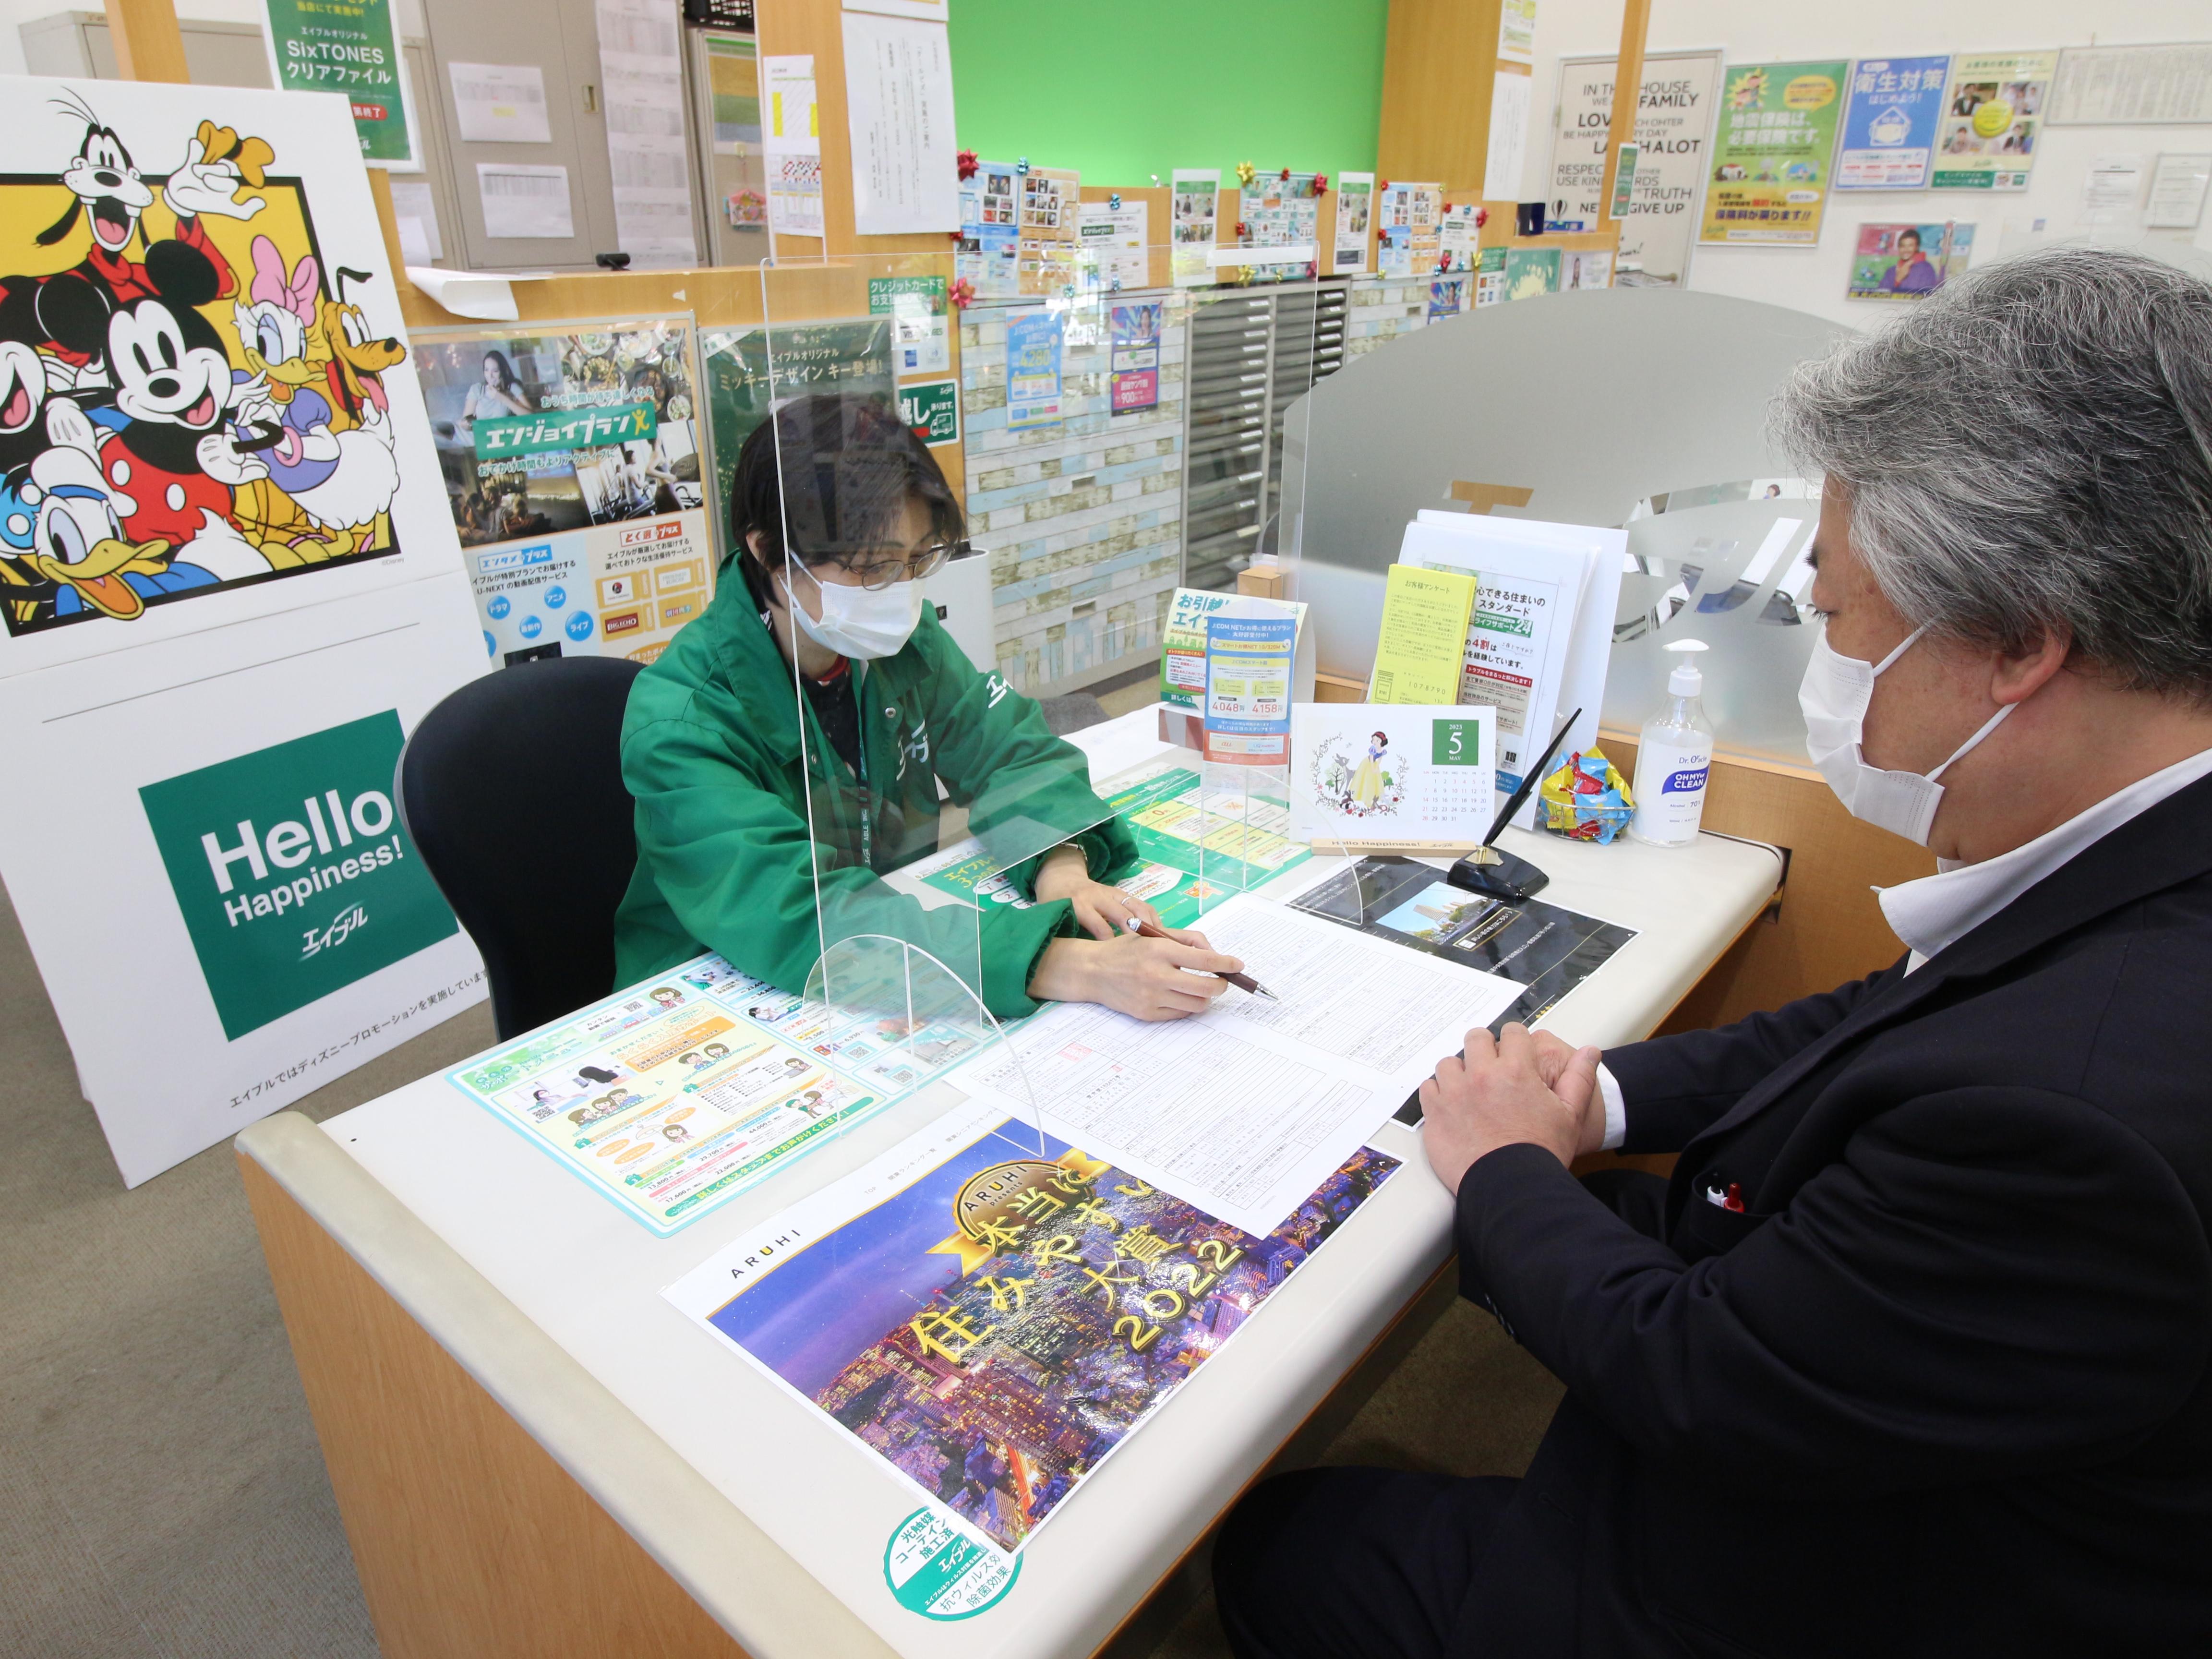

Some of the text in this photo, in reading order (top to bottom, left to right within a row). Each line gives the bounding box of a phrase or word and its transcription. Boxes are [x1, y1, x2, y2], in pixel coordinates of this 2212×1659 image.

[287, 40, 384, 64] SixTONES
[287, 61, 391, 84] クリアファイル
[1854, 69, 1944, 94] 衛生対策
[1584, 81, 1691, 95] IN HOUSE
[1592, 94, 1699, 108] WE FAMILY
[1578, 113, 1611, 127] LOV
[1563, 131, 1575, 139] BE
[1647, 129, 1667, 138] DAY
[1557, 176, 1659, 186] USE KIN RDS
[1558, 164, 1603, 175] RESPEC
[1643, 188, 1692, 200] TRUTH
[1629, 203, 1684, 214] GIVE UP
[870, 278, 944, 293] クレジットカードで
[770, 349, 839, 363] エイブルオリジナル
[721, 365, 823, 390] ミッキーデザイン
[541, 385, 655, 408] おうち時間が待ち遠しくなる
[486, 413, 630, 449] エンジョイプラン
[472, 559, 576, 585] イブルが特別プランでお届けする
[477, 583, 505, 595] U-NEXT
[546, 592, 565, 603] アニメ
[1405, 580, 1450, 594] お客様アンケート
[1476, 586, 1546, 607] 心できる住まいの
[490, 603, 508, 614] ドラマ
[1479, 599, 1530, 617] スタンダード
[570, 621, 589, 633] ライブ
[1474, 617, 1533, 635] ライフサポート 24
[1467, 666, 1531, 686] トラブルをまるっと解決します!
[1448, 732, 1462, 755] 5
[1674, 779, 1704, 789] CLEAN
[201, 788, 393, 894] Hello
[224, 835, 404, 927] Happiness!
[301, 902, 368, 954] エイブル
[887, 1147, 937, 1180] 関東ランキング一覧
[864, 1186, 877, 1195] TOP
[965, 1164, 1029, 1212] ARUHI
[988, 1180, 1023, 1207] presents
[978, 1168, 1095, 1256] 本当に
[730, 1229, 801, 1279] ARUHI
[911, 1180, 1155, 1368] 住みやすい
[1078, 1224, 1184, 1310] 大賞
[1113, 1240, 1244, 1352] 2022
[900, 1511, 937, 1544] 光触媒
[895, 1518, 946, 1564] コーティン
[919, 1527, 955, 1560] 施工済
[966, 1565, 1011, 1608] 除菌効果
